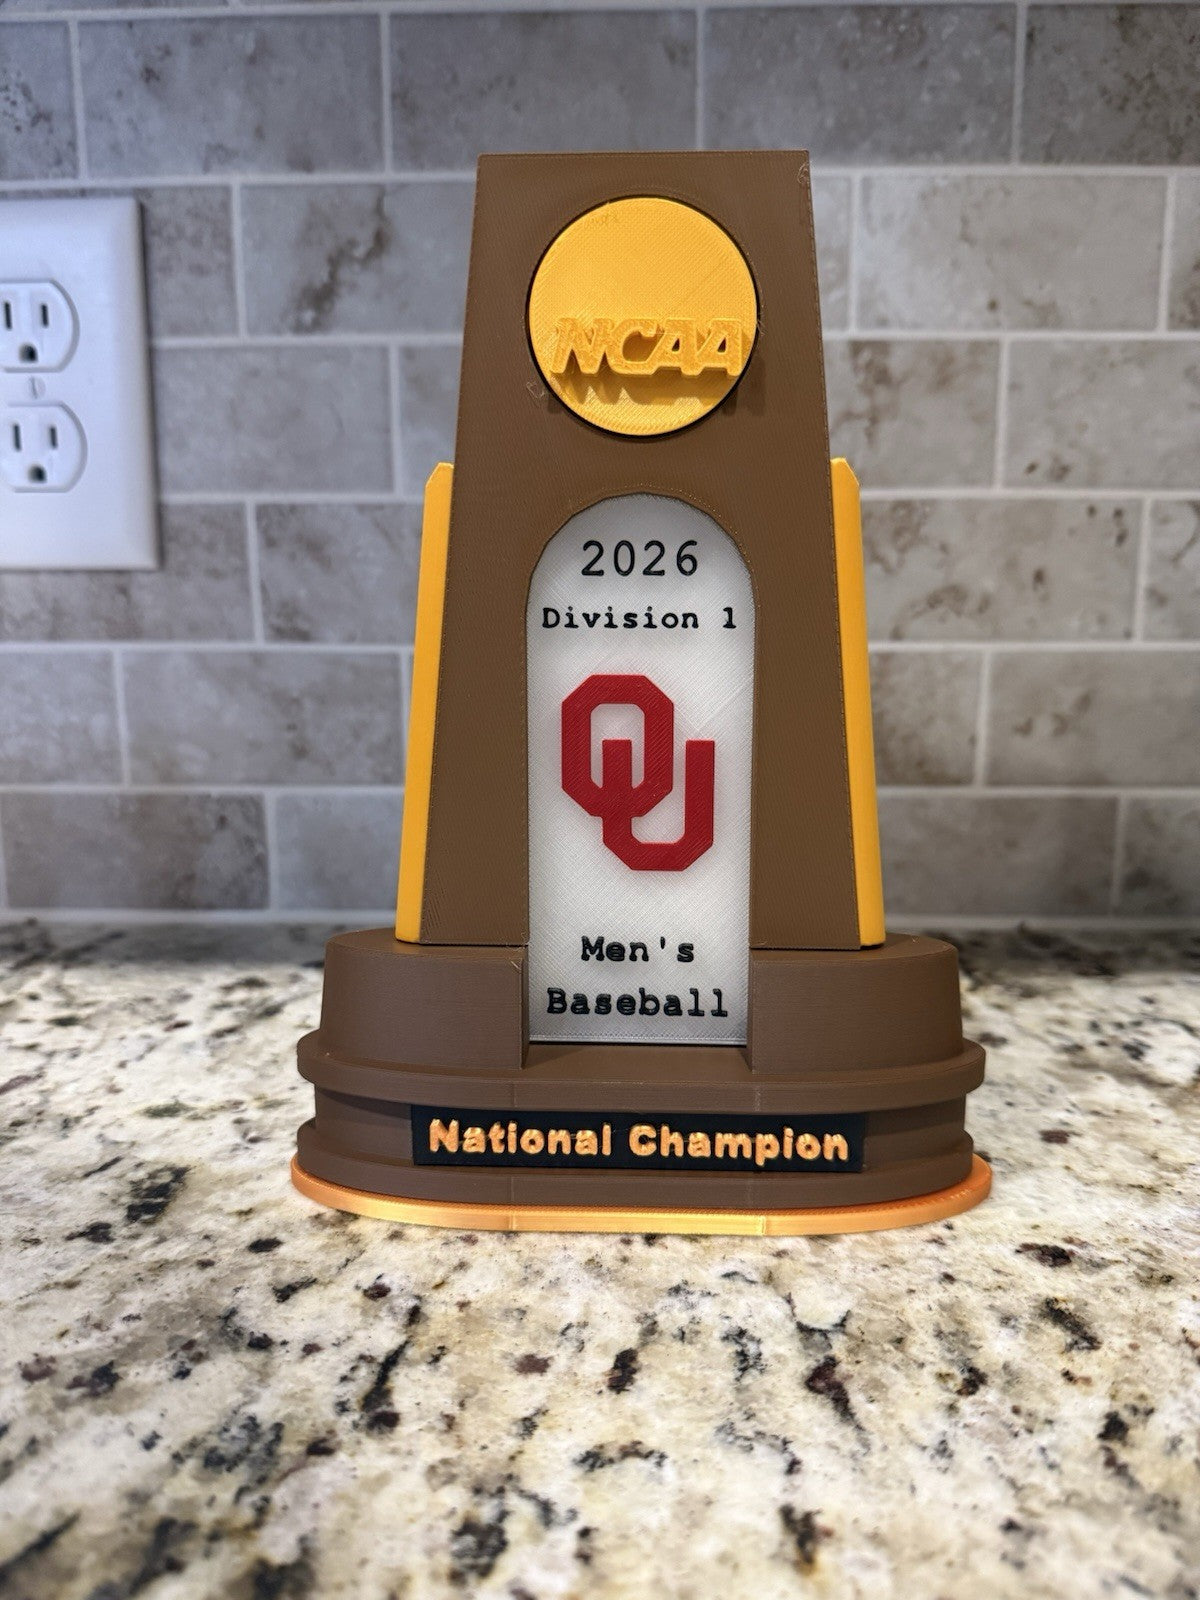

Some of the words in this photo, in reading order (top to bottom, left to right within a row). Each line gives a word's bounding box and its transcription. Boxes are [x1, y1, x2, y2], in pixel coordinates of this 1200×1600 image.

[551, 317, 742, 376] NCAA
[581, 539, 698, 576] 2026
[542, 606, 699, 629] Division
[722, 606, 737, 629] 1
[561, 674, 715, 871] OU
[581, 935, 695, 962] Men's
[547, 987, 728, 1017] Baseball
[429, 1119, 612, 1156] National
[628, 1123, 849, 1167] Champion
